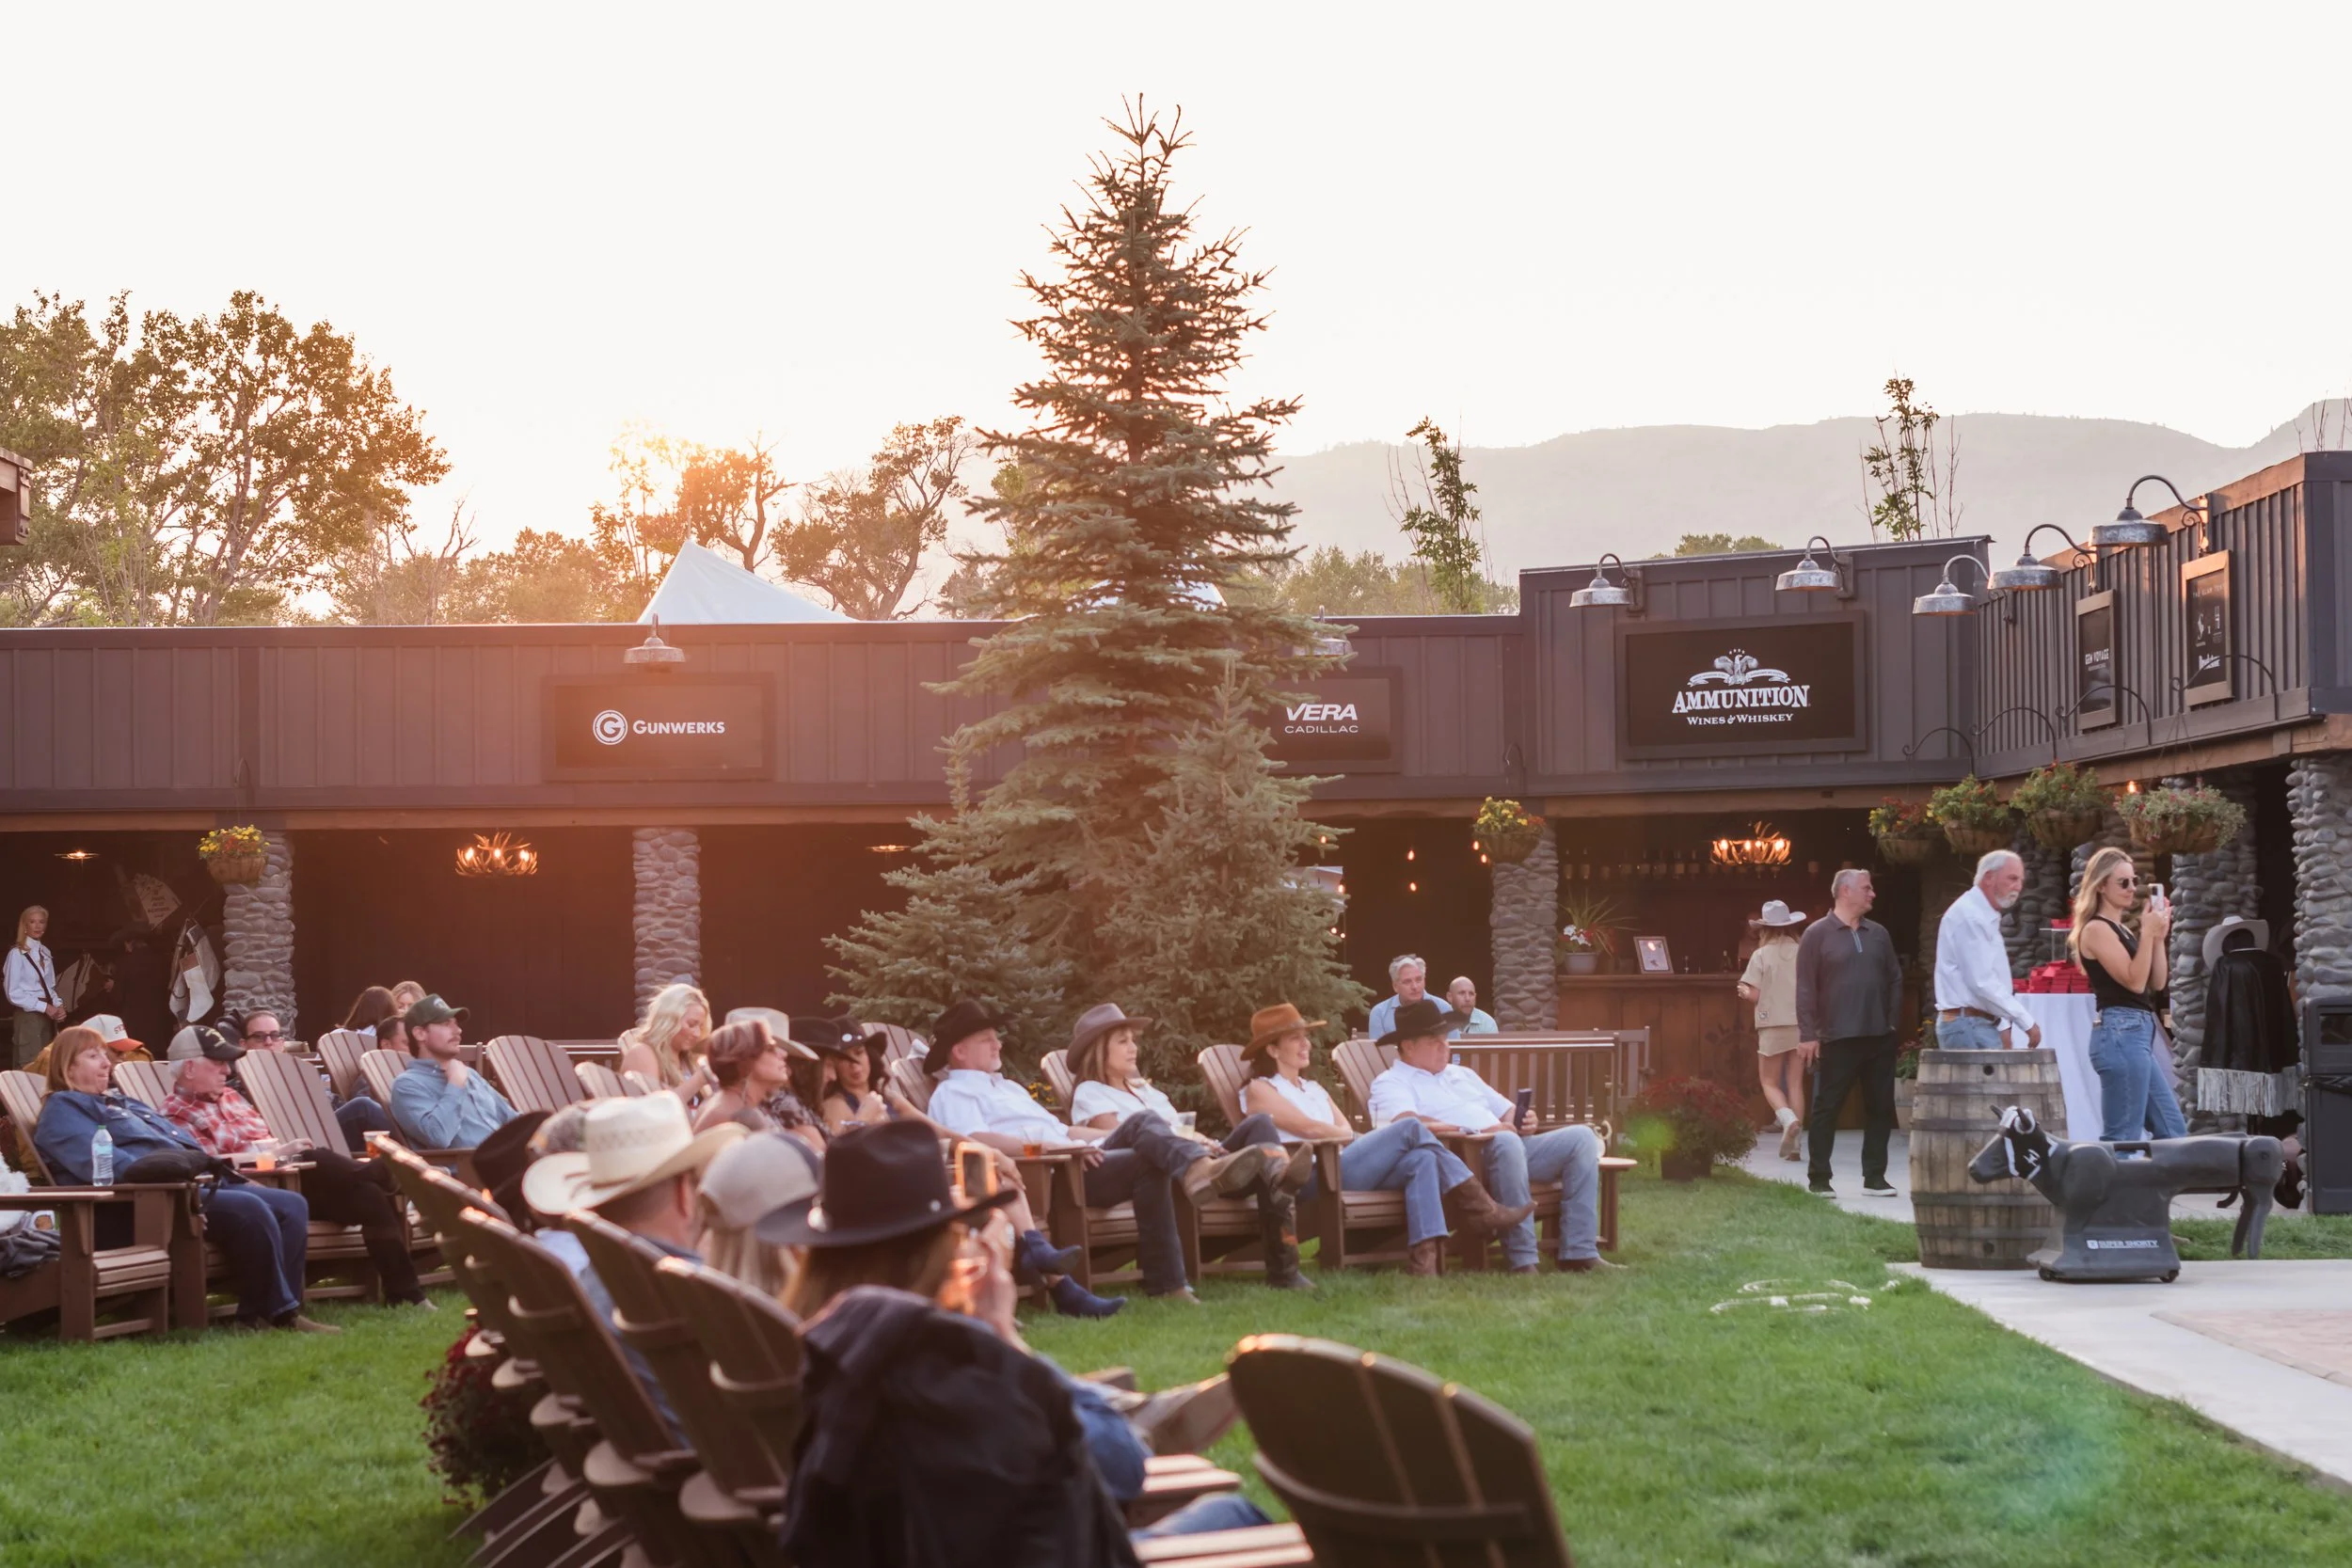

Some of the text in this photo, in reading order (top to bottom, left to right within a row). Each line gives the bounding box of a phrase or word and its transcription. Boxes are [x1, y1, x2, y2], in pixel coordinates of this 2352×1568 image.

[1672, 685, 1810, 713] AMMUNITION
[1286, 703, 1359, 721] VERA
[1687, 713, 1794, 725] WINES & WHISKEY
[632, 720, 725, 735] GUNWERKS
[1284, 725, 1359, 734] CADILLAC
